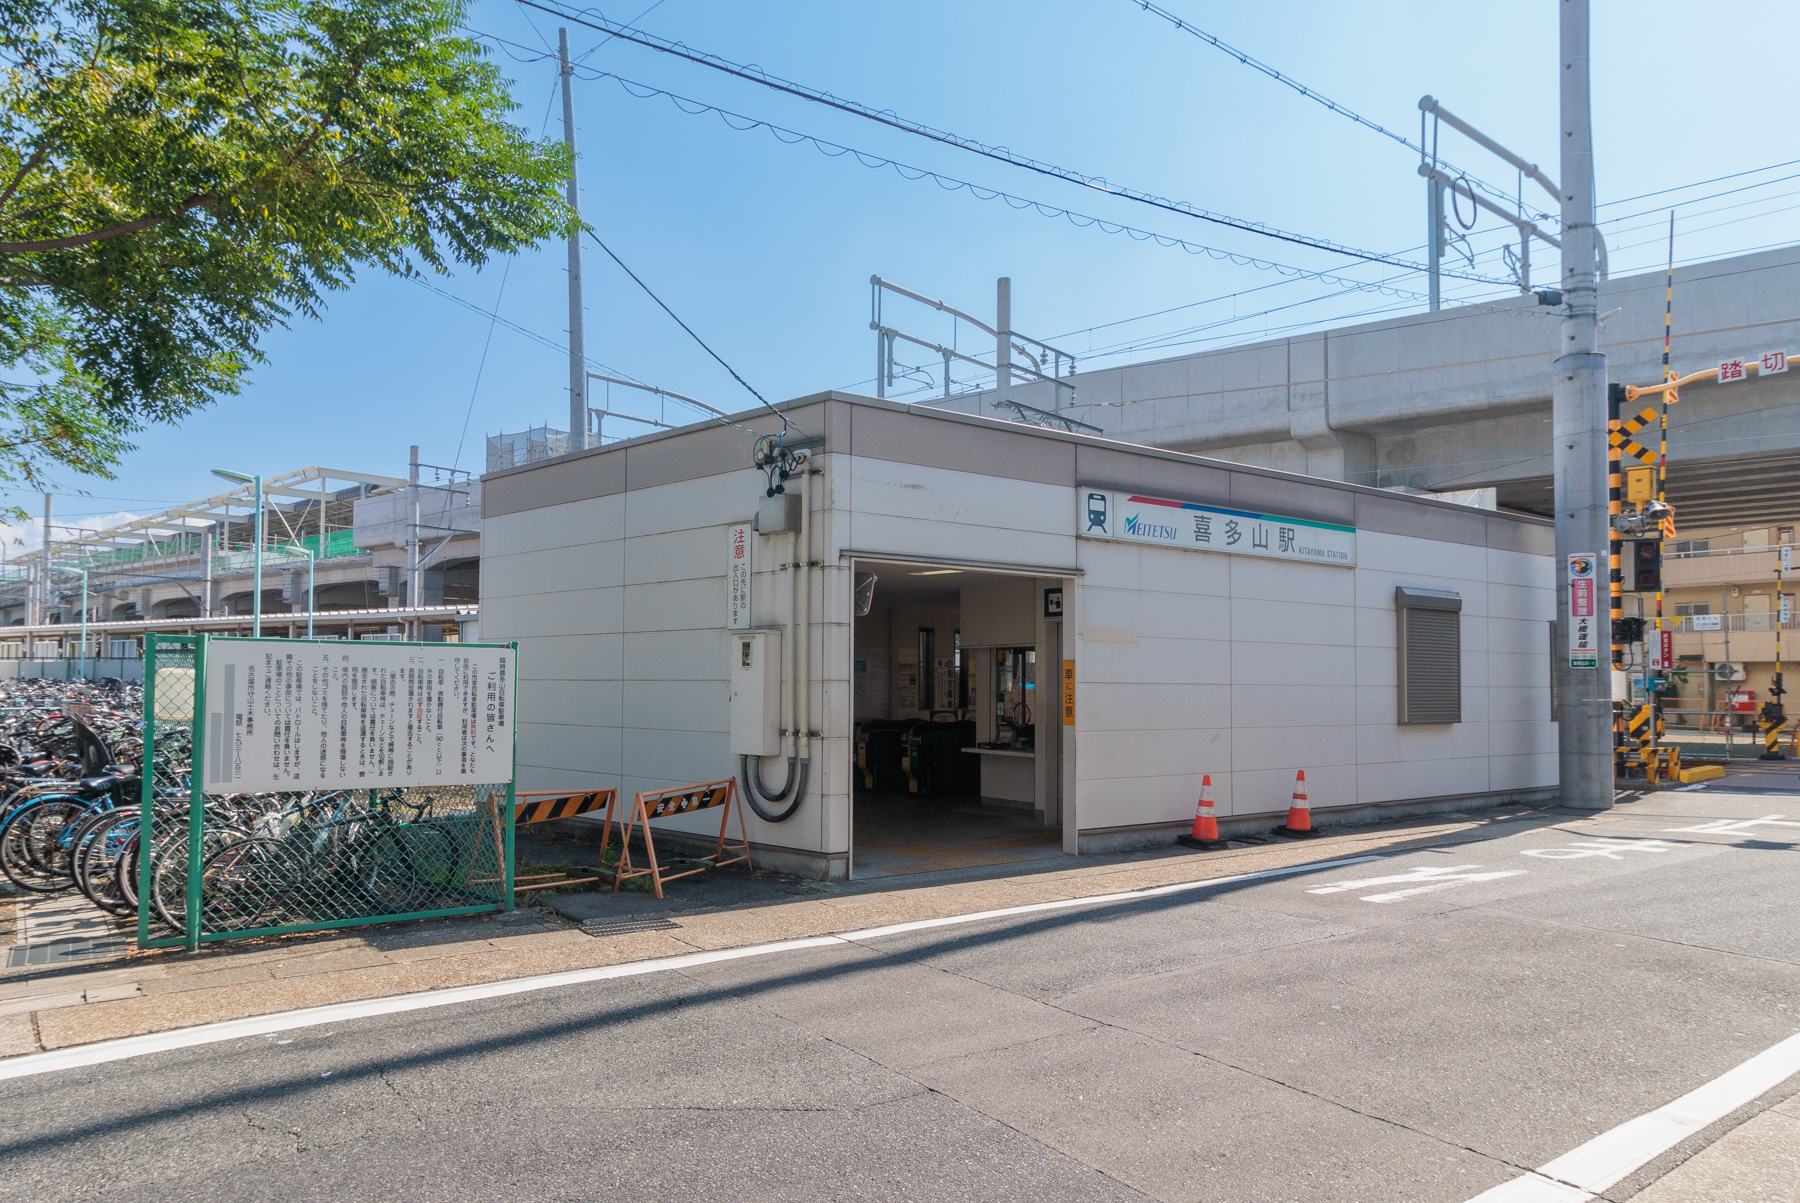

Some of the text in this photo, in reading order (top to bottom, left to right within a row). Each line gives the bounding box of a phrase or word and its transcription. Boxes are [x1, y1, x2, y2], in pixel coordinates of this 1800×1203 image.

[1721, 352, 1785, 380] 踏切
[1124, 512, 1177, 540] MEITETSU
[1193, 515, 1295, 553] 喜多山駅
[734, 529, 746, 559] 注意
[1298, 546, 1348, 561] KITAYAMA STATION
[1578, 580, 1588, 616] 生前整理
[1065, 668, 1073, 718] 車に注意
[236, 714, 243, 726] 電話
[486, 671, 496, 752] ご利用の皆さんへ
